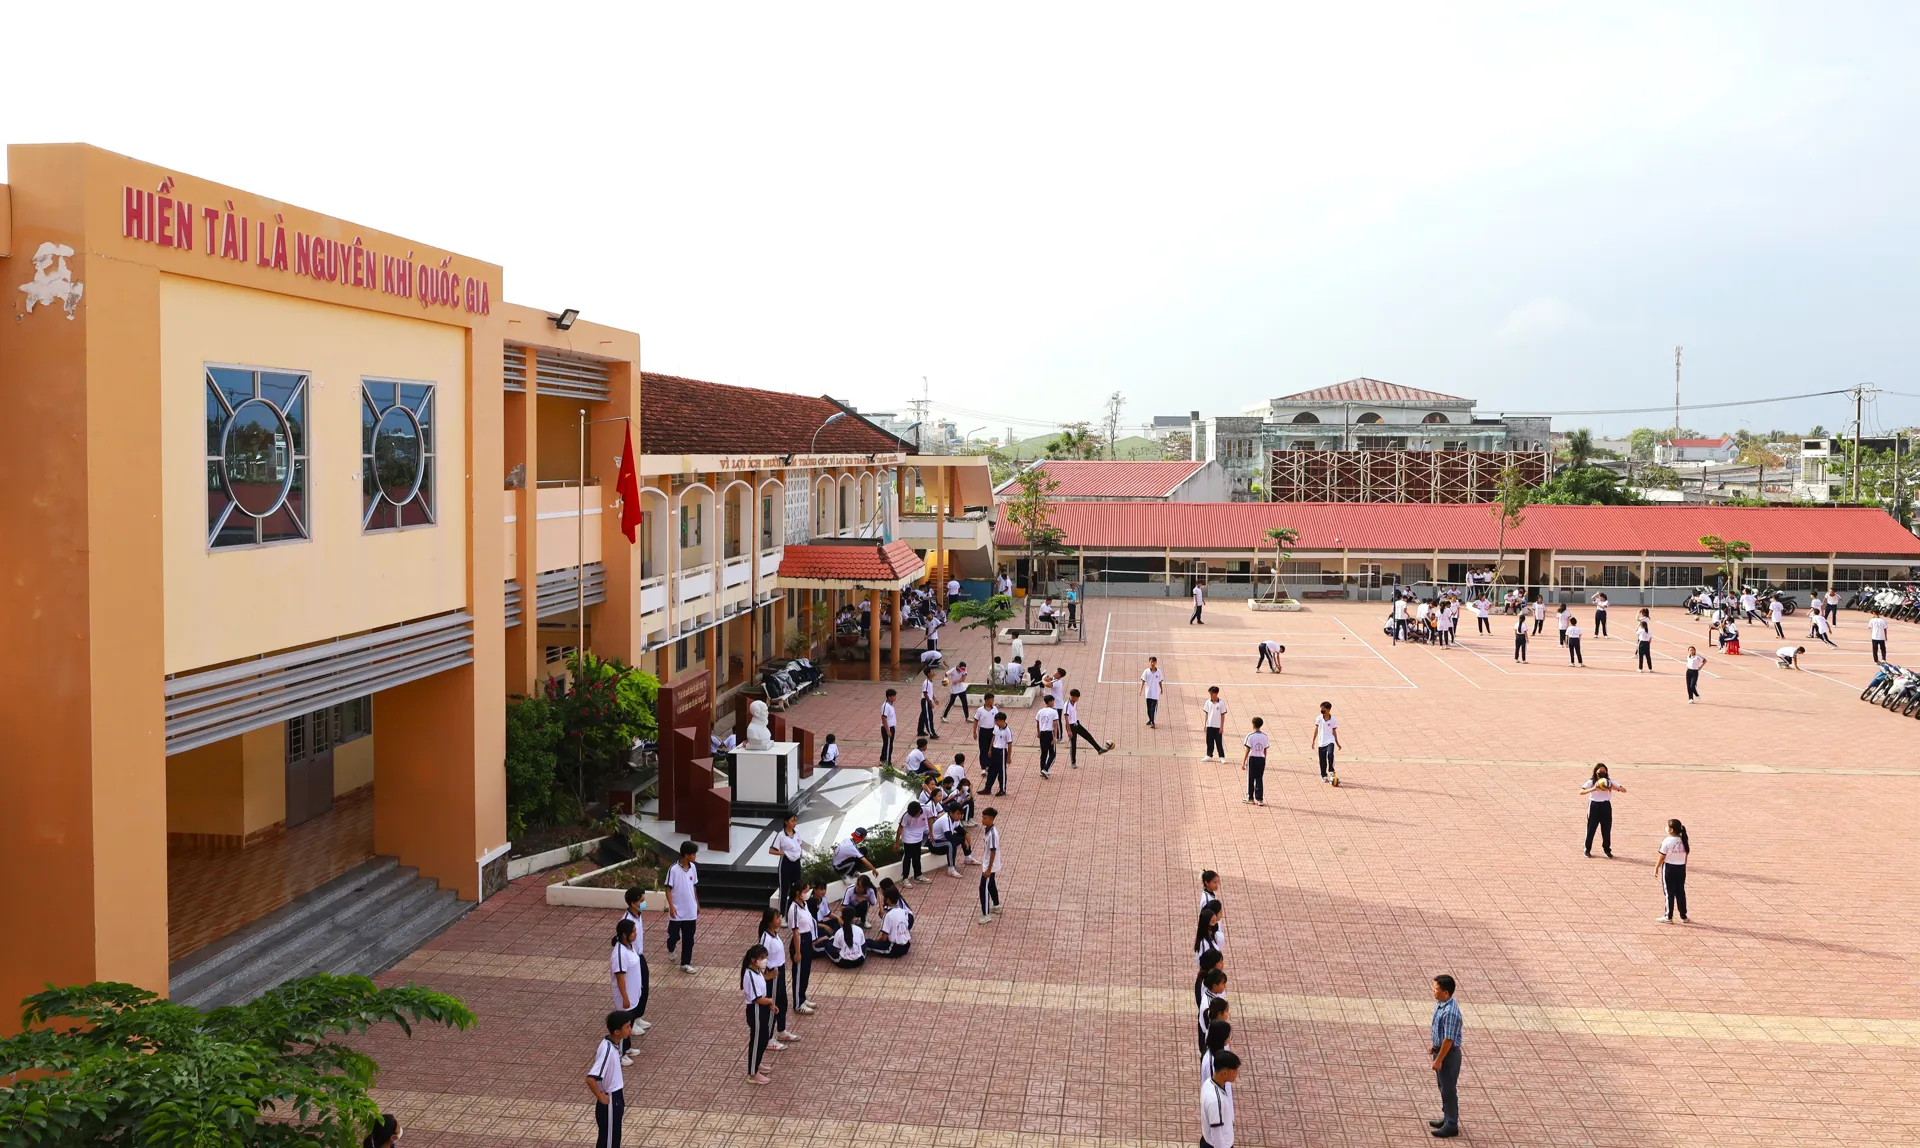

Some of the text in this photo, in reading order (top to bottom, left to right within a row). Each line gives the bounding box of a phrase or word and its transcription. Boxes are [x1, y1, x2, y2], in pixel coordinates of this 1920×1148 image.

[123, 176, 490, 315] HIỀN TÀI LÀ NGUYÊN KHÍ QUỐC GIA
[720, 456, 730, 469] VÌ
[732, 458, 746, 470] LỢI
[748, 456, 761, 469] ÍCH
